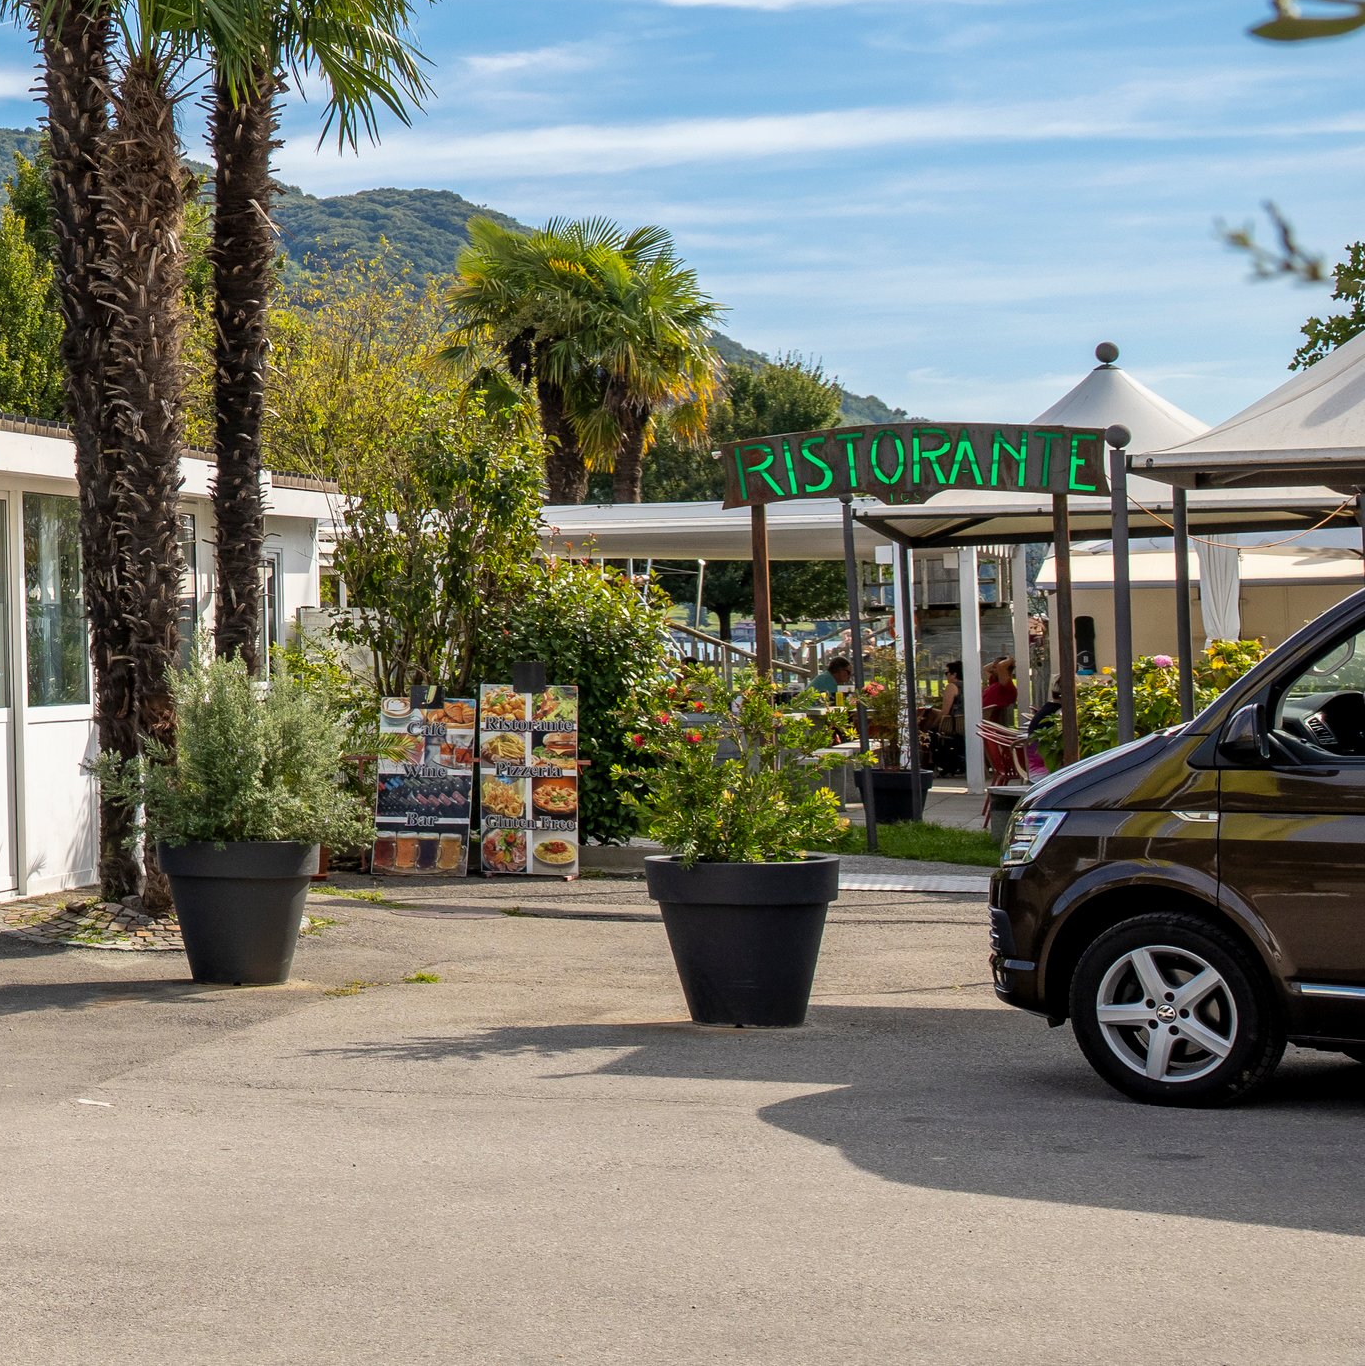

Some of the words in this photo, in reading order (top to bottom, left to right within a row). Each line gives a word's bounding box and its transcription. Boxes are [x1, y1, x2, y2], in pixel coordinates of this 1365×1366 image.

[734, 429, 1097, 500] RISTORANTE
[407, 721, 447, 736] Café
[484, 716, 573, 732] Ristorante
[403, 763, 447, 778] Wine
[494, 761, 563, 778] Pizzeria
[405, 812, 438, 827] Bar
[485, 815, 537, 831] Gluten
[539, 816, 576, 831] Free
